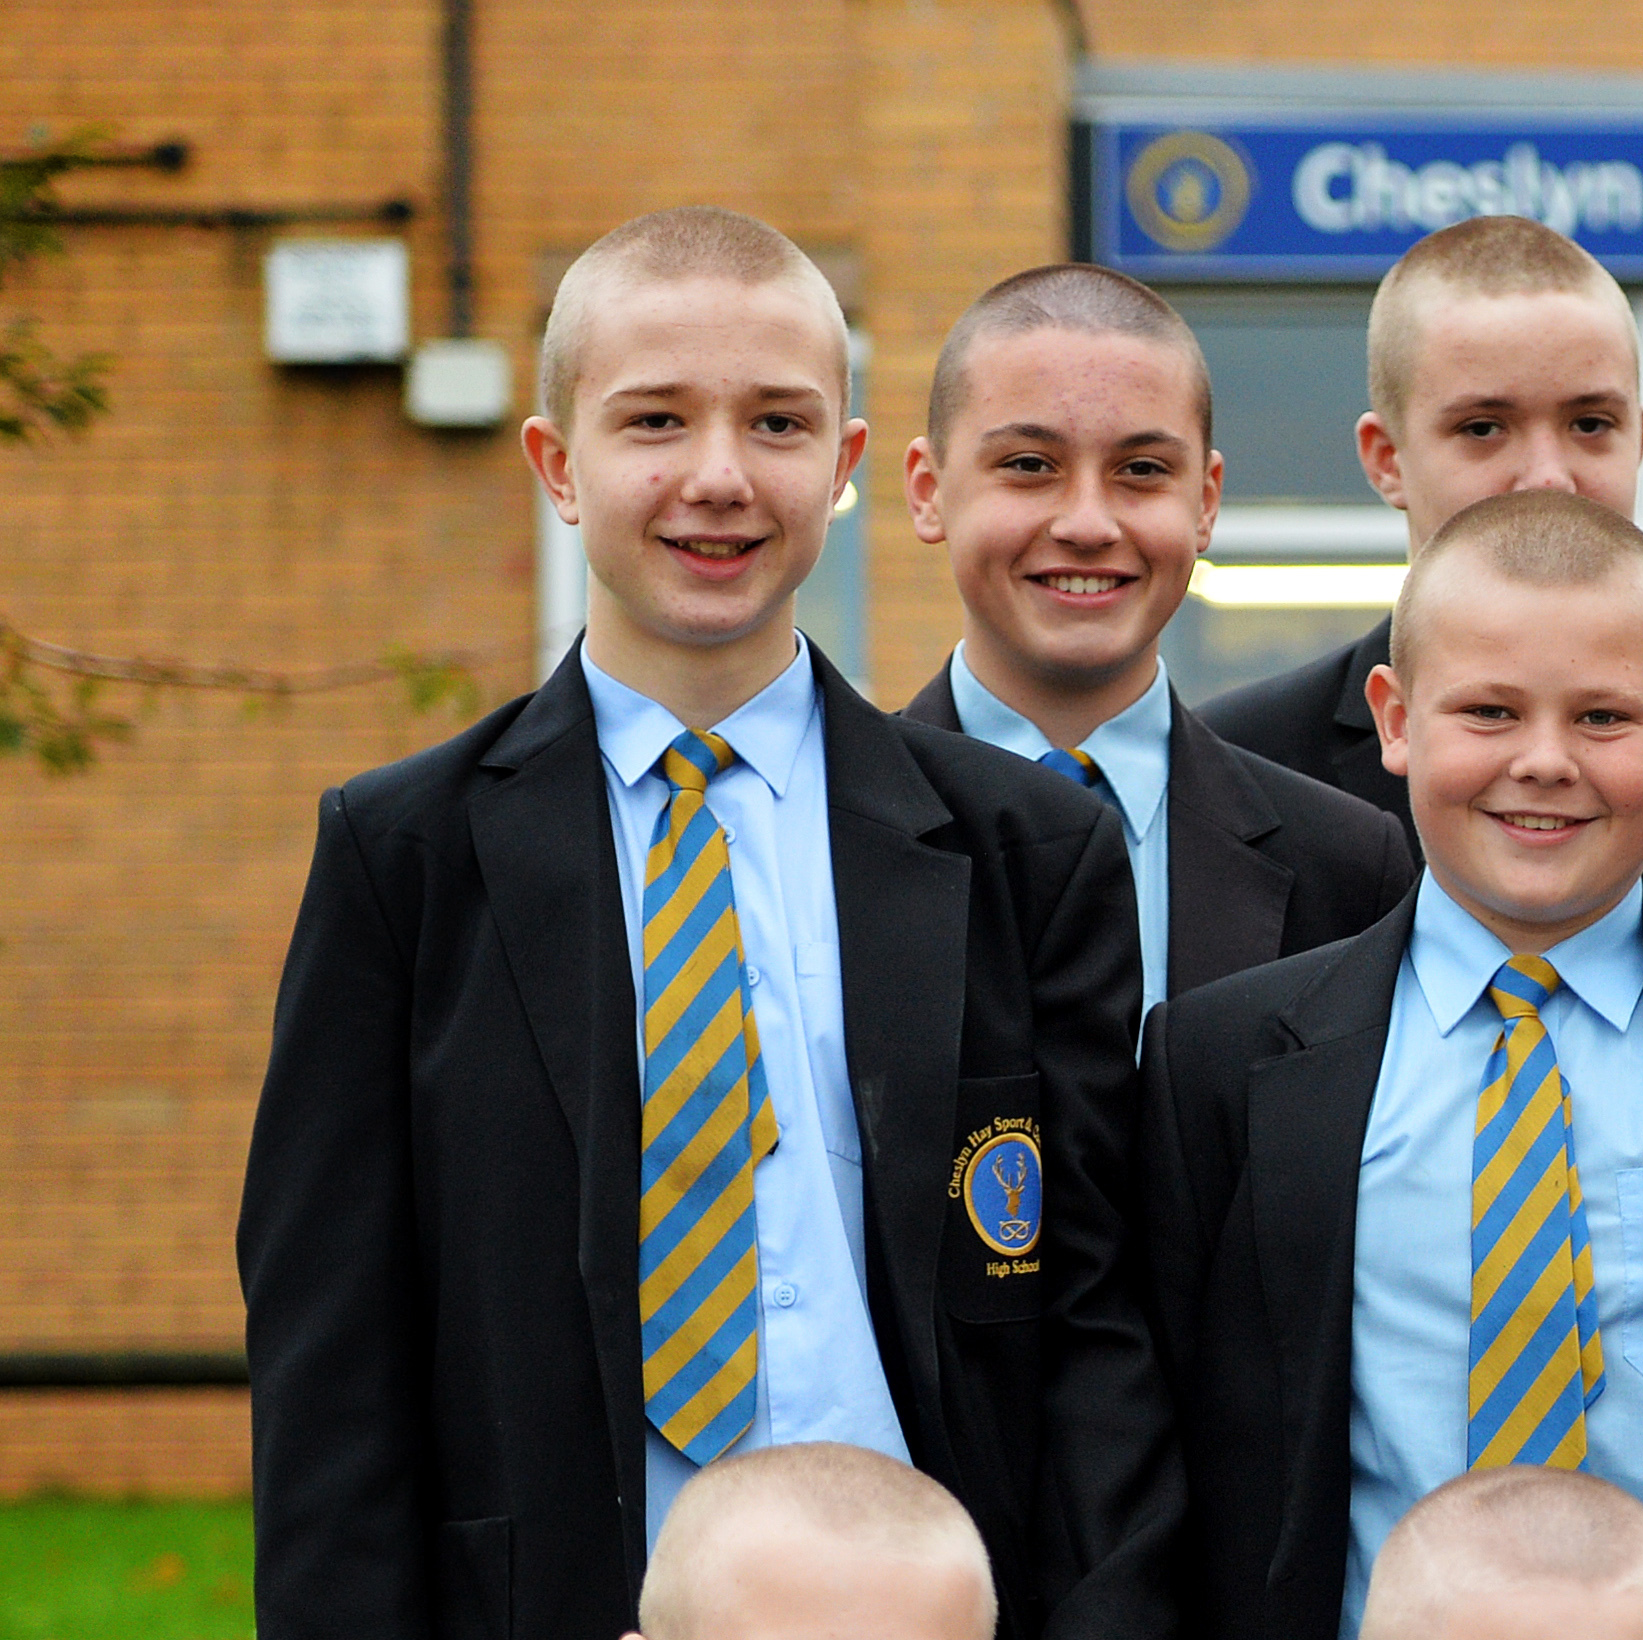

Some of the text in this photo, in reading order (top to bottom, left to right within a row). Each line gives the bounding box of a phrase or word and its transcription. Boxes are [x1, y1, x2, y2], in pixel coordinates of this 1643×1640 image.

[948, 1146, 972, 1199] Cheslyn
[968, 1124, 992, 1148] Hay
[994, 1116, 1025, 1132] Sport
[986, 1259, 1040, 1279] High School
